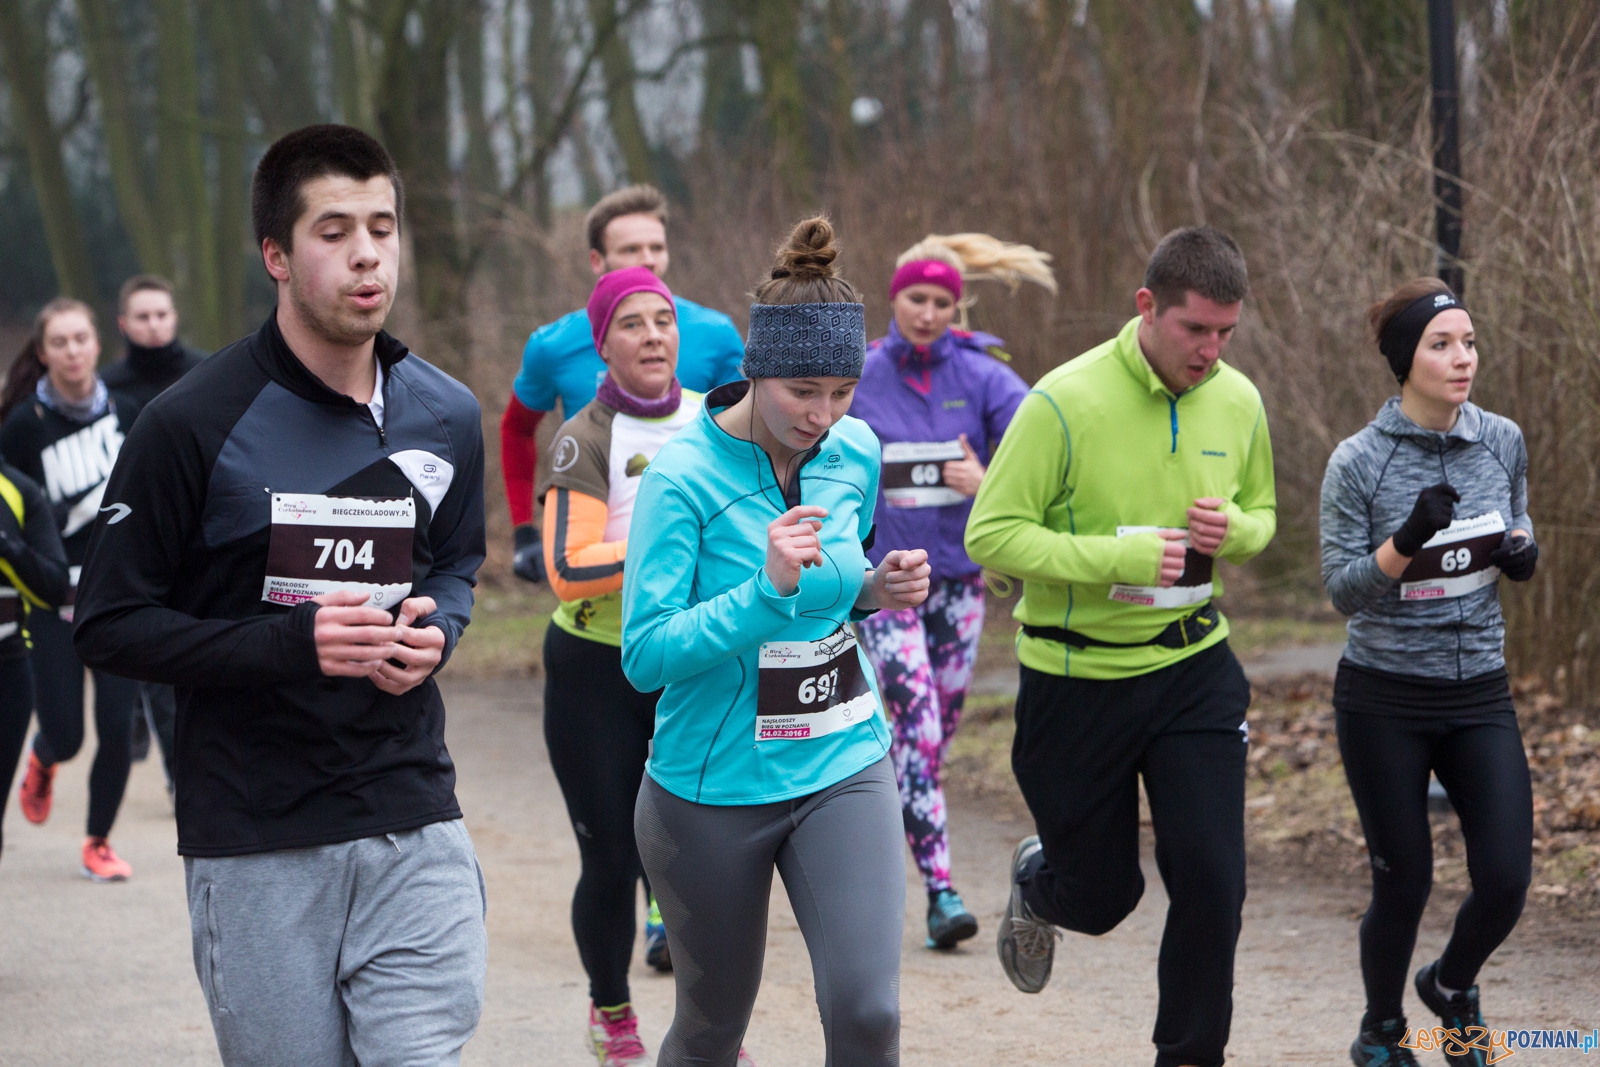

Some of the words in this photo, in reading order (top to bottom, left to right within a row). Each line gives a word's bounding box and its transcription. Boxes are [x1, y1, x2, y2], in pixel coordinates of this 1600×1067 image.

[40, 412, 125, 504] NIKE
[332, 508, 410, 517] BIEGCZEKOLADOWY.PL
[313, 538, 375, 570] 704
[1441, 547, 1472, 572] 69
[798, 667, 839, 705] 697
